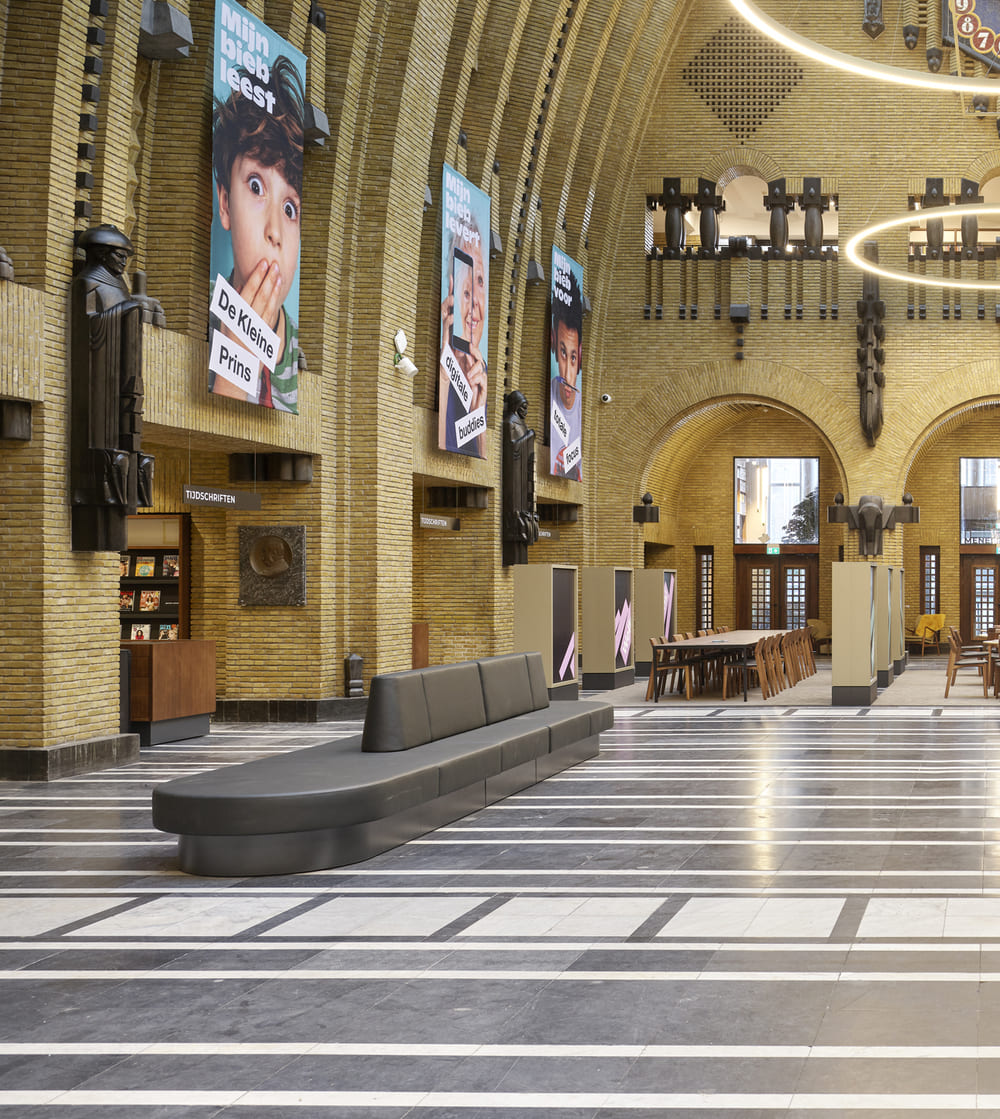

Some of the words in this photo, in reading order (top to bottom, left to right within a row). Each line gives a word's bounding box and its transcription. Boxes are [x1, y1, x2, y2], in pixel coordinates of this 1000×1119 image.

[221, 2, 269, 58] Mijn
[961, 16, 974, 33] 8
[977, 32, 989, 49] 7
[220, 29, 269, 84] bieb
[220, 57, 276, 114] leest
[446, 171, 471, 204] Mijn
[446, 191, 471, 223] bieb
[446, 211, 480, 248] levert
[554, 251, 571, 276] Mijn
[554, 266, 571, 291] bieb
[554, 285, 573, 307] voor
[218, 288, 236, 320] De
[237, 308, 274, 359] Kleine
[219, 345, 252, 383] Prins
[445, 356, 469, 402] digitale
[458, 415, 485, 440] buddies
[554, 409, 567, 438] totale
[566, 446, 579, 465] focus
[186, 490, 236, 504] TIJDSCHRIFTEN
[964, 537, 1000, 545] MENE
